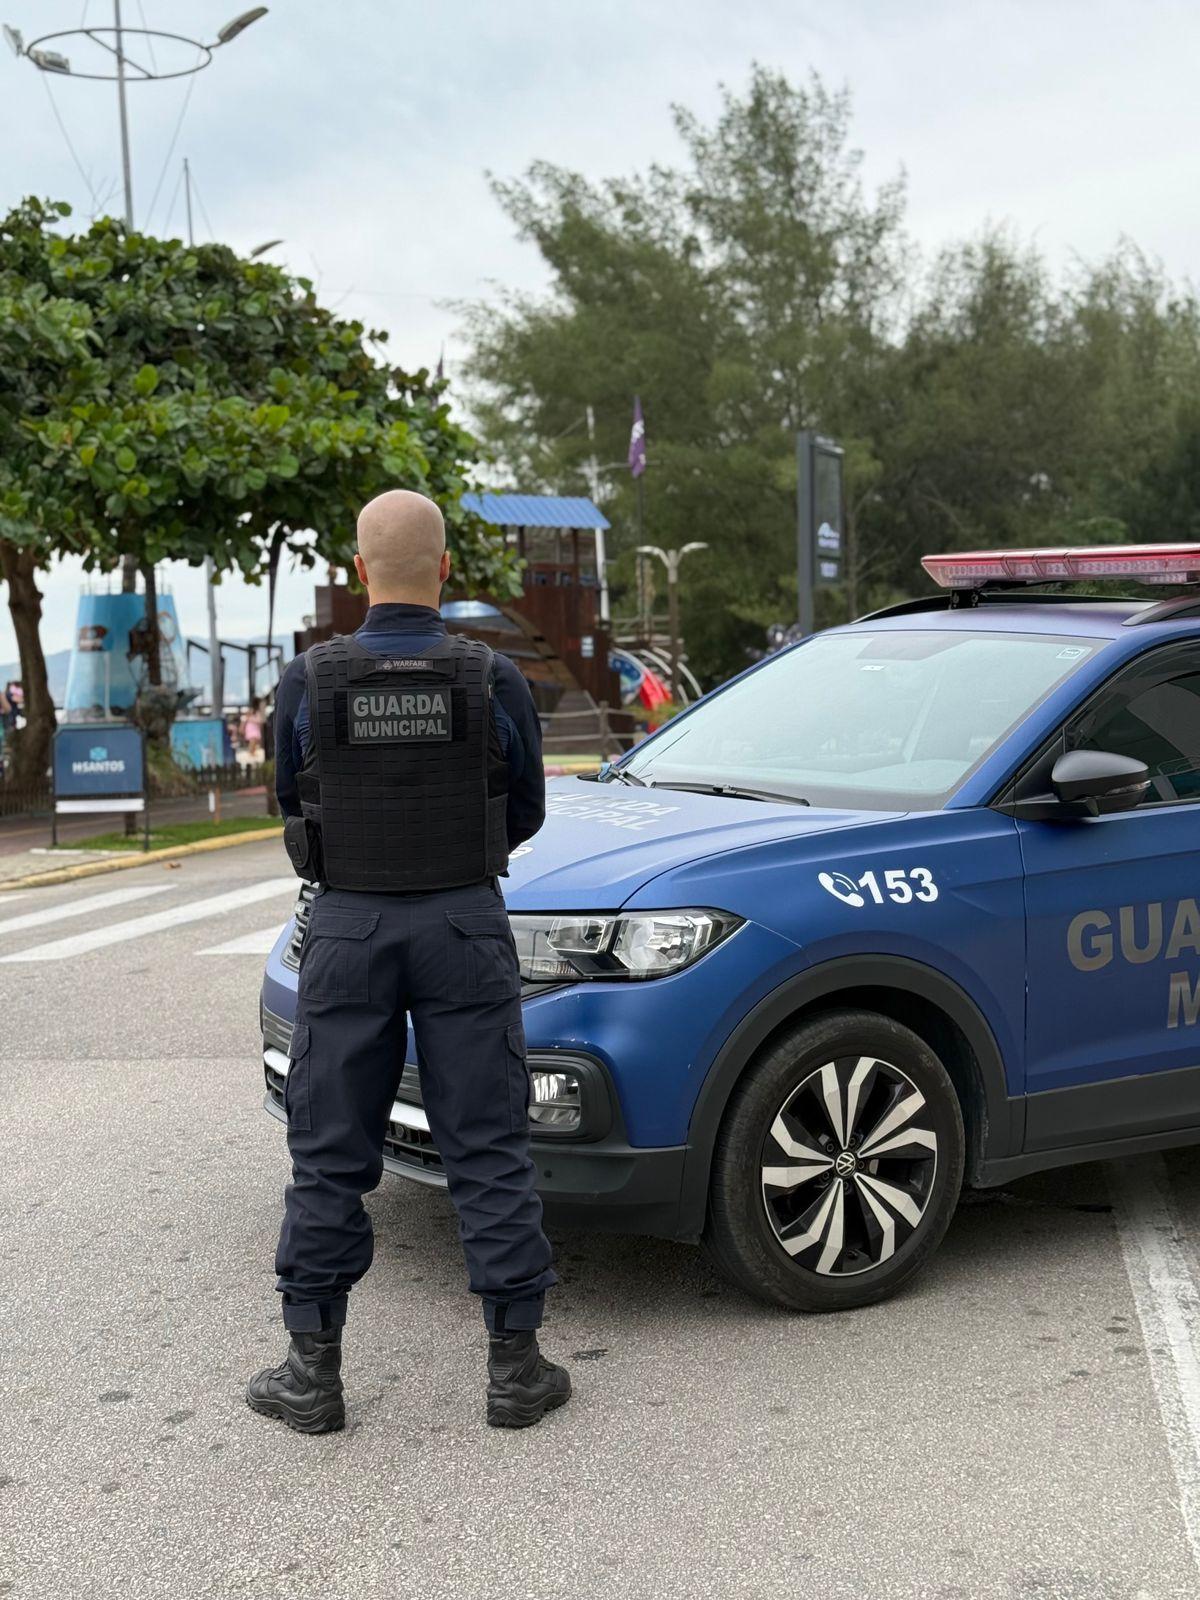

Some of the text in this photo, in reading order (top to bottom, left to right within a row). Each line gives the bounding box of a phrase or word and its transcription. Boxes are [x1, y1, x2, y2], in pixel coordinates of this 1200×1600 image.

[353, 694, 447, 717] GUARDA
[354, 719, 447, 738] MUNICIPAL
[545, 802, 661, 831] ICIPAL
[546, 793, 682, 817] UARDA
[858, 867, 939, 904] 153
[1067, 898, 1200, 972] GUA
